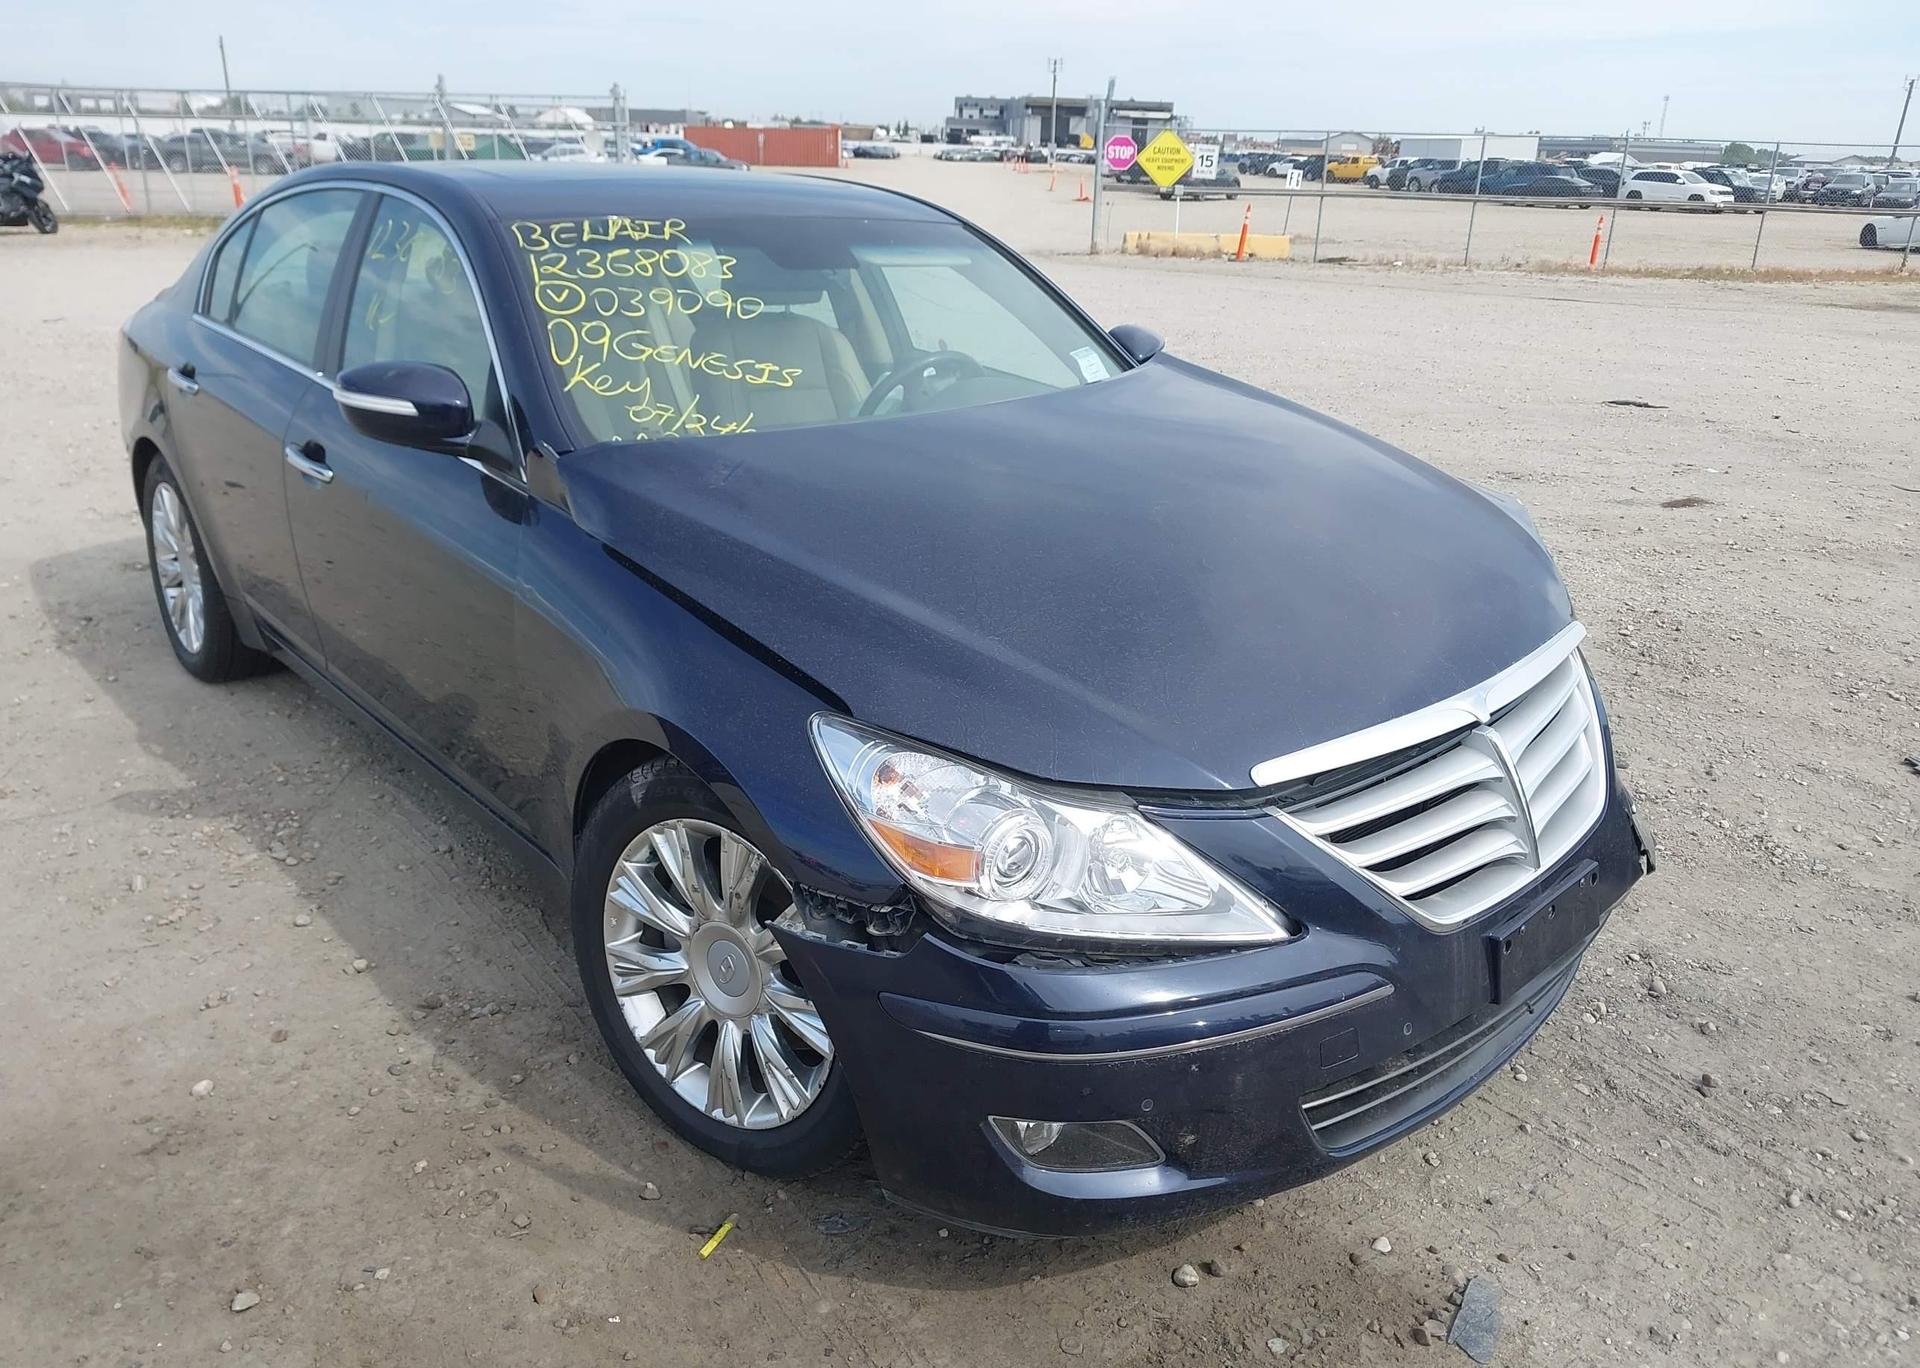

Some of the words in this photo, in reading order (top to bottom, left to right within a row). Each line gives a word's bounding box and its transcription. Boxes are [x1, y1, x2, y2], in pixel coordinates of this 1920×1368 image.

[1108, 145, 1134, 159] STOP
[1153, 146, 1181, 154] CAUTION
[1198, 154, 1214, 168] 15
[563, 354, 652, 409] Key
